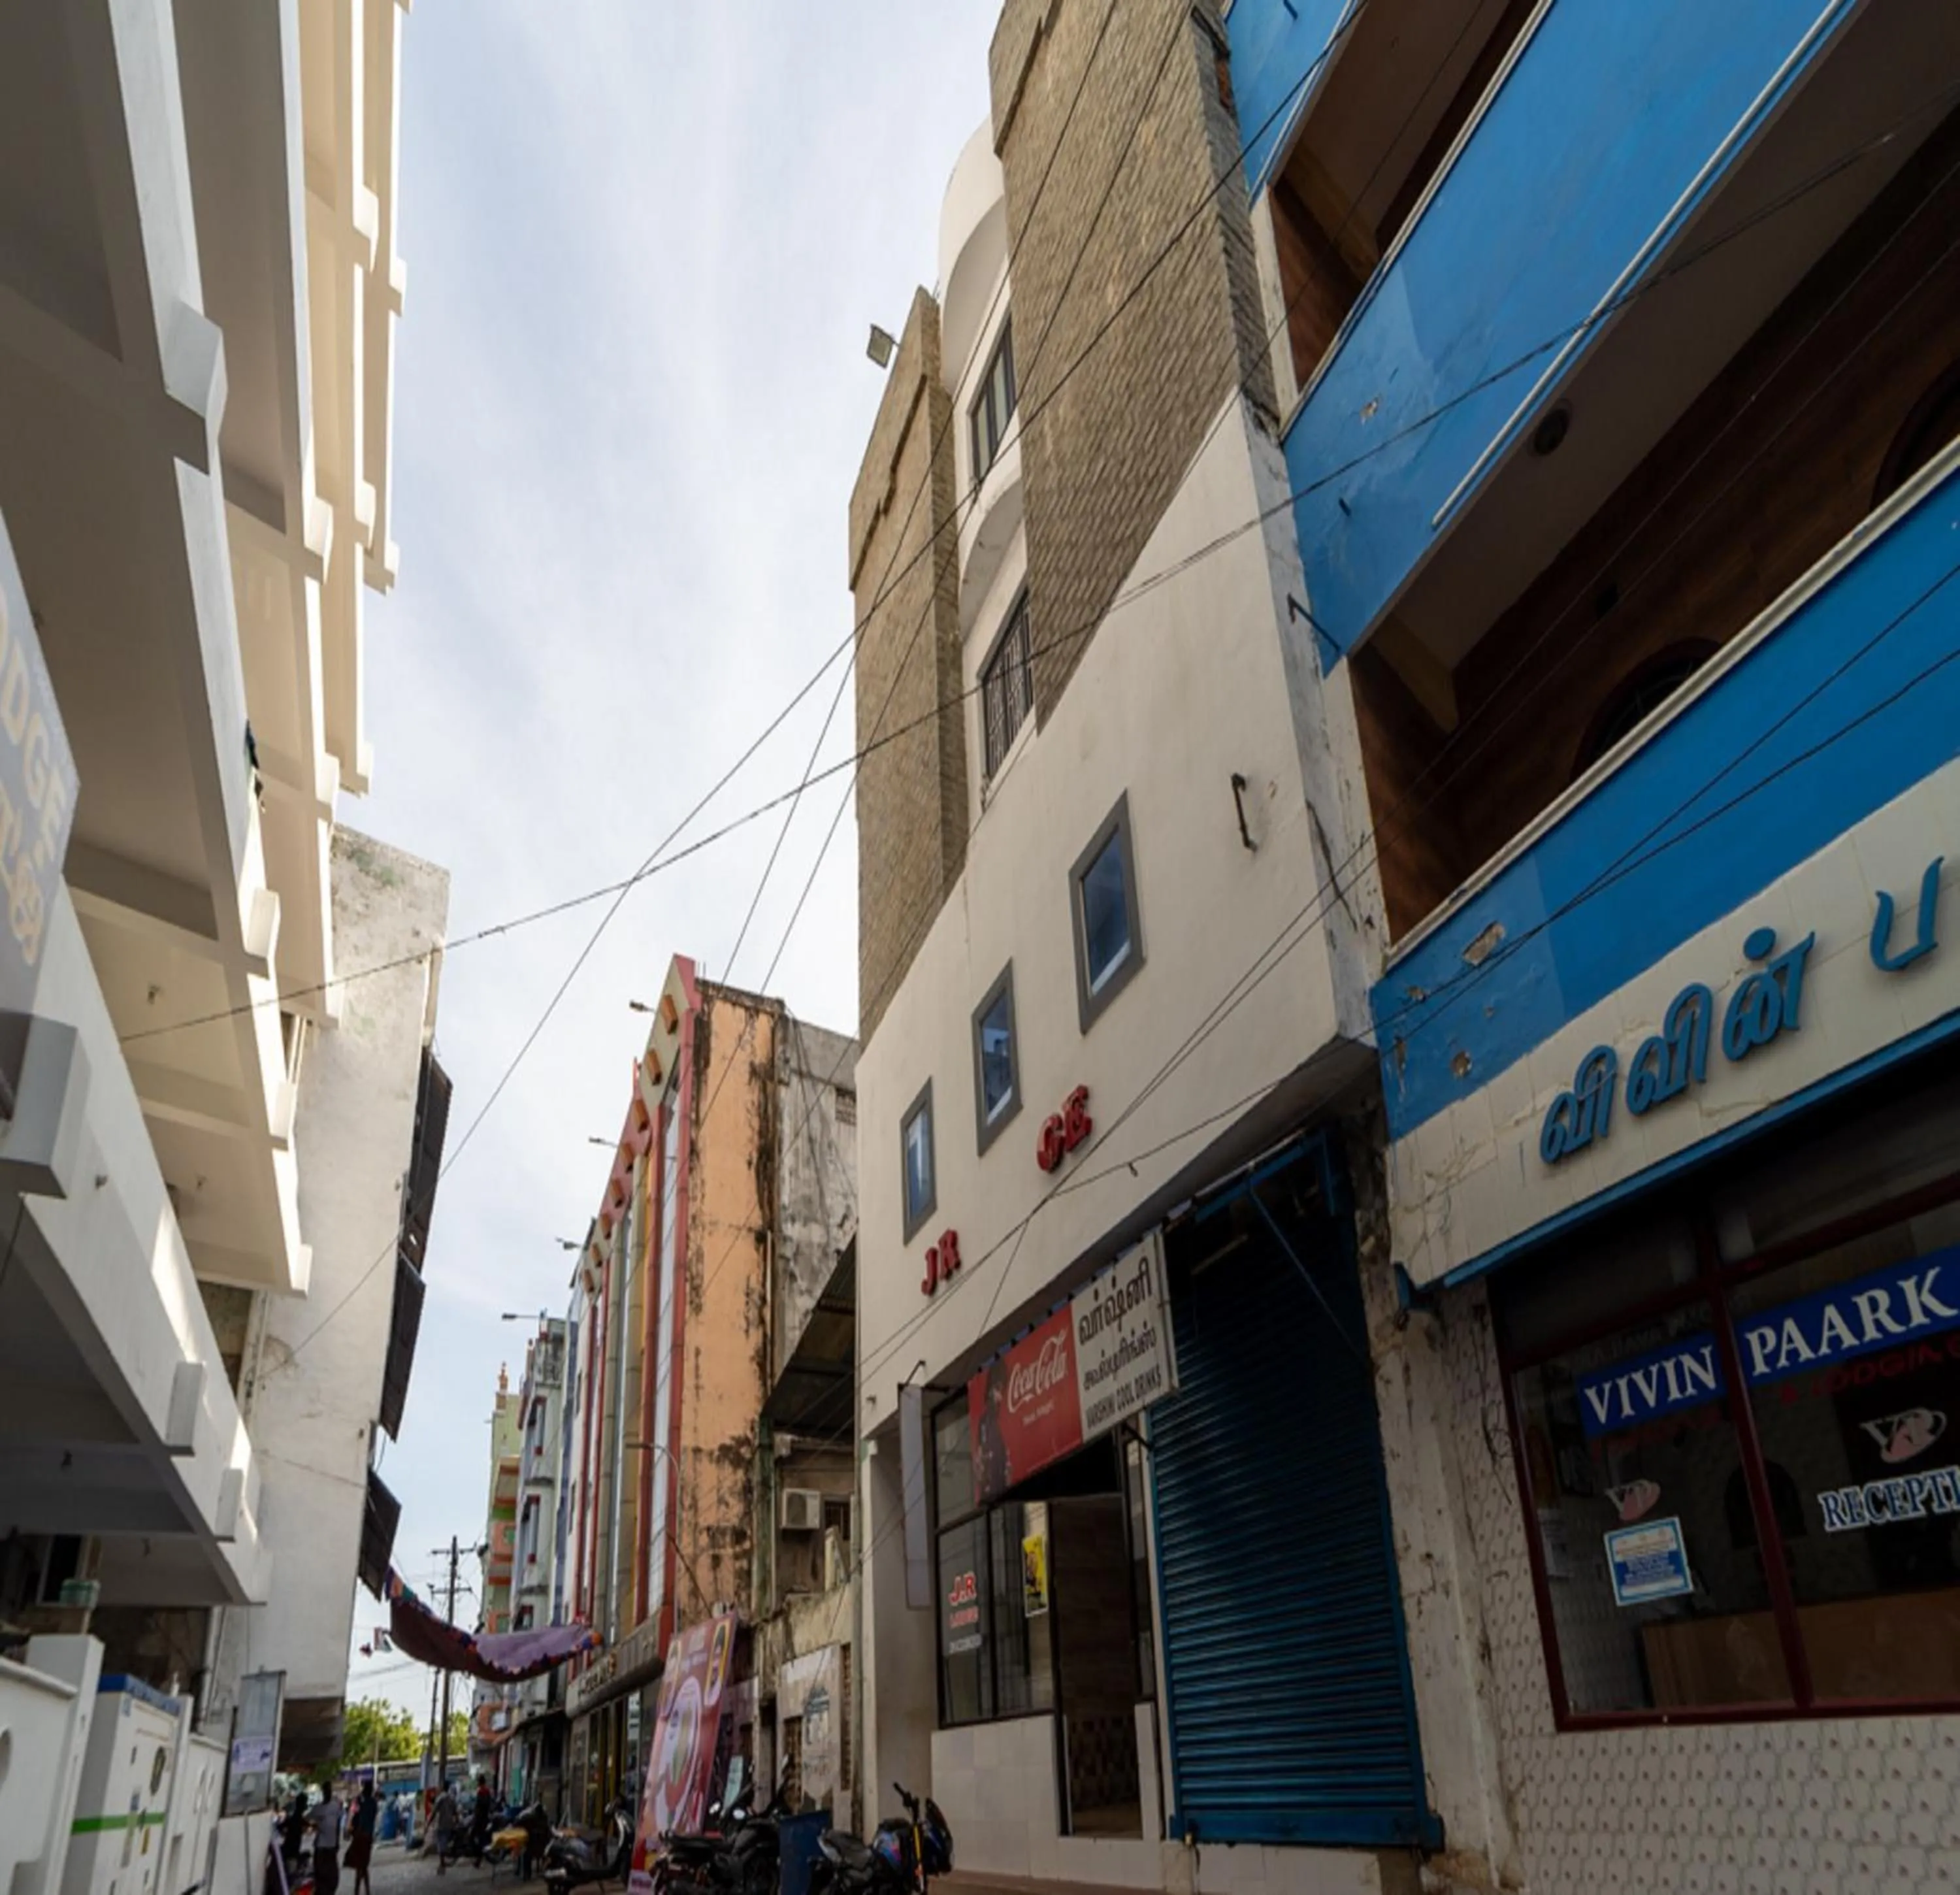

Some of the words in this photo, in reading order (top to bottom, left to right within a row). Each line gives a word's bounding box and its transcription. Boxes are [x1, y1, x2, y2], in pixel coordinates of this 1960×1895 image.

[1540, 927, 1815, 1164] விவின்
[921, 1228, 961, 1297] JR
[1583, 1343, 1718, 1425] VIVIN
[1745, 1266, 1960, 1377] PAARK
